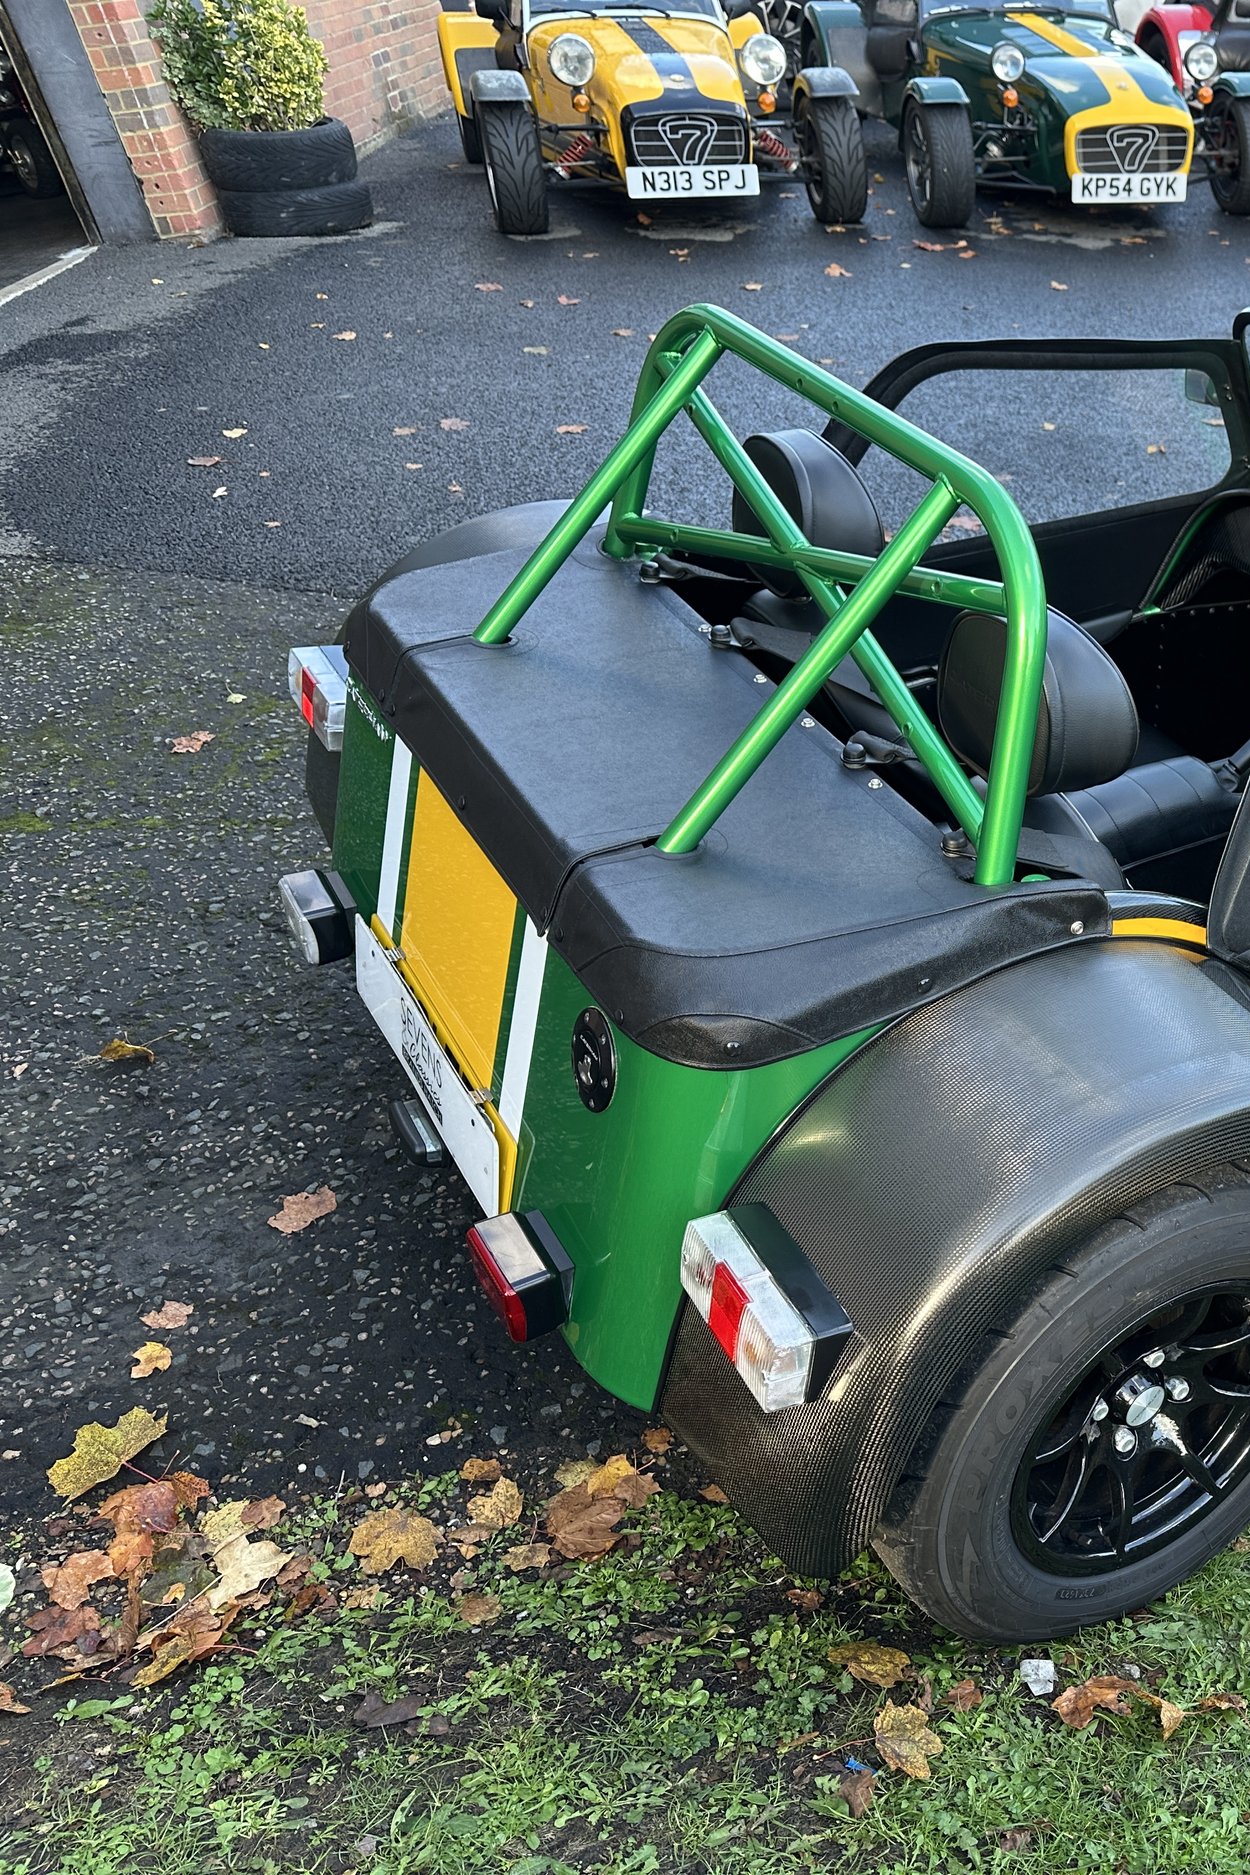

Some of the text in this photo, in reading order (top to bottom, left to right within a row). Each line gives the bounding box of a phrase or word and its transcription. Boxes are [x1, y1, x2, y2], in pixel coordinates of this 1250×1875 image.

[665, 119, 712, 164] 7
[1113, 127, 1154, 171] 7
[641, 169, 746, 193] N313 SPJ
[1081, 176, 1178, 198] KP54 GYK
[400, 997, 443, 1088] SEVENS
